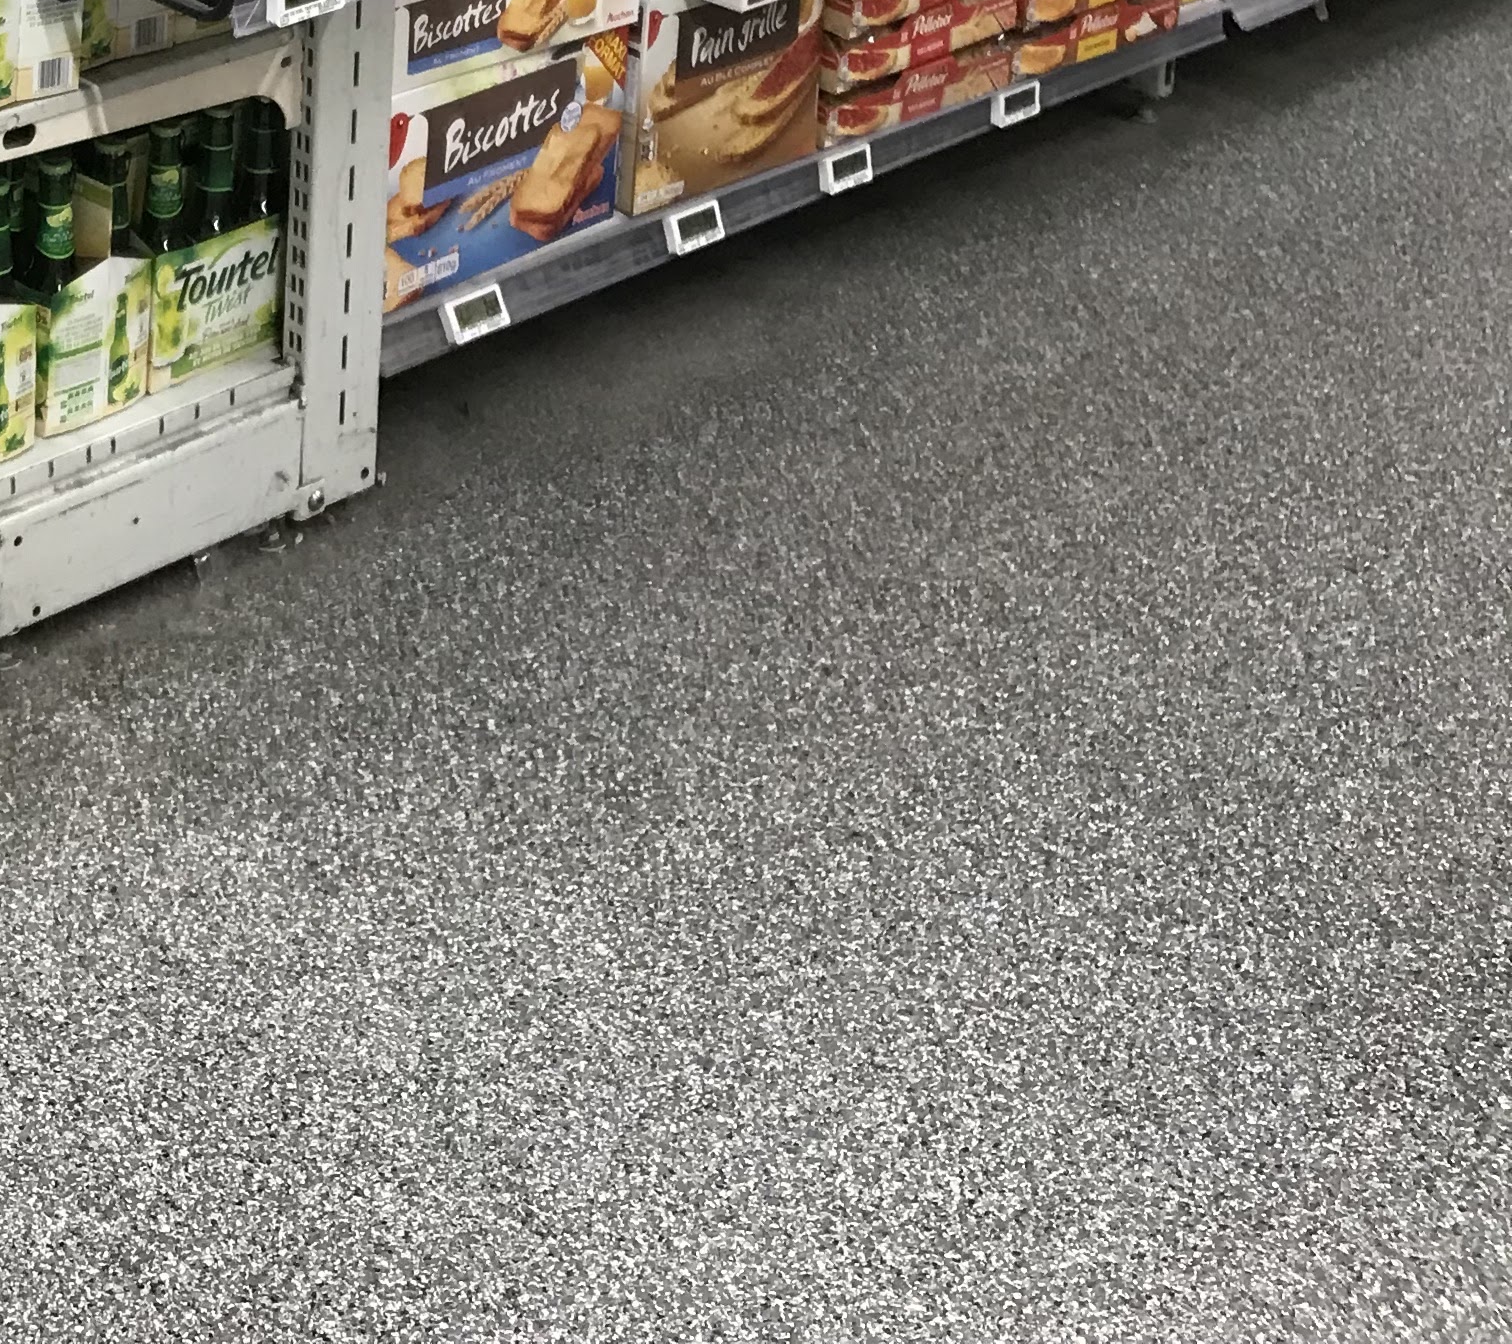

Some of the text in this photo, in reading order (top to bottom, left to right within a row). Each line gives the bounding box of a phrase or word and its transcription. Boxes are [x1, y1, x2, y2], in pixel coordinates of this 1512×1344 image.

[690, 25, 734, 69] Pain
[443, 88, 560, 175] Biscottes
[175, 236, 282, 312] Tourtel
